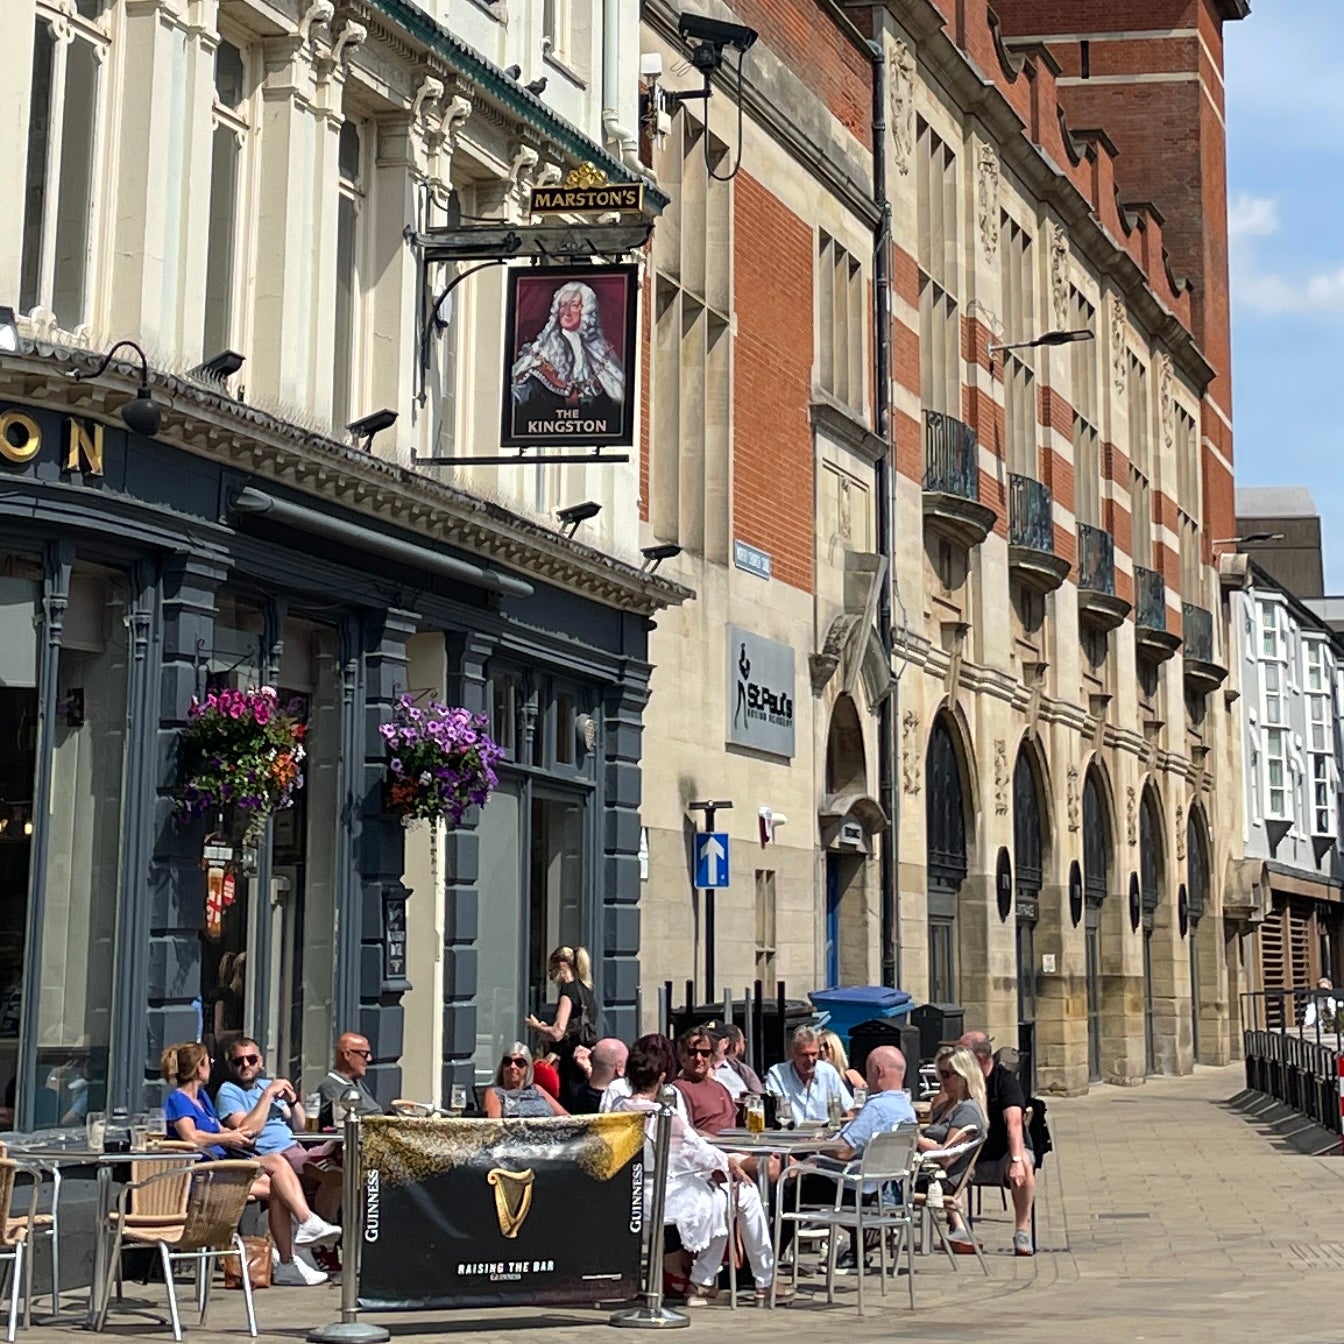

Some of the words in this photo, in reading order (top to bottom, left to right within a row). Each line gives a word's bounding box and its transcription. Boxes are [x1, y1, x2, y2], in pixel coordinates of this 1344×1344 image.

[535, 189, 636, 207] MARSTON'S
[556, 409, 580, 419] THE
[528, 420, 607, 433] KINGSTON
[364, 1169, 380, 1243] GUINNESS
[629, 1162, 644, 1234] GUINNESS
[457, 1263, 505, 1275] RAISING
[508, 1261, 530, 1273] THE
[532, 1260, 554, 1273] BAR
